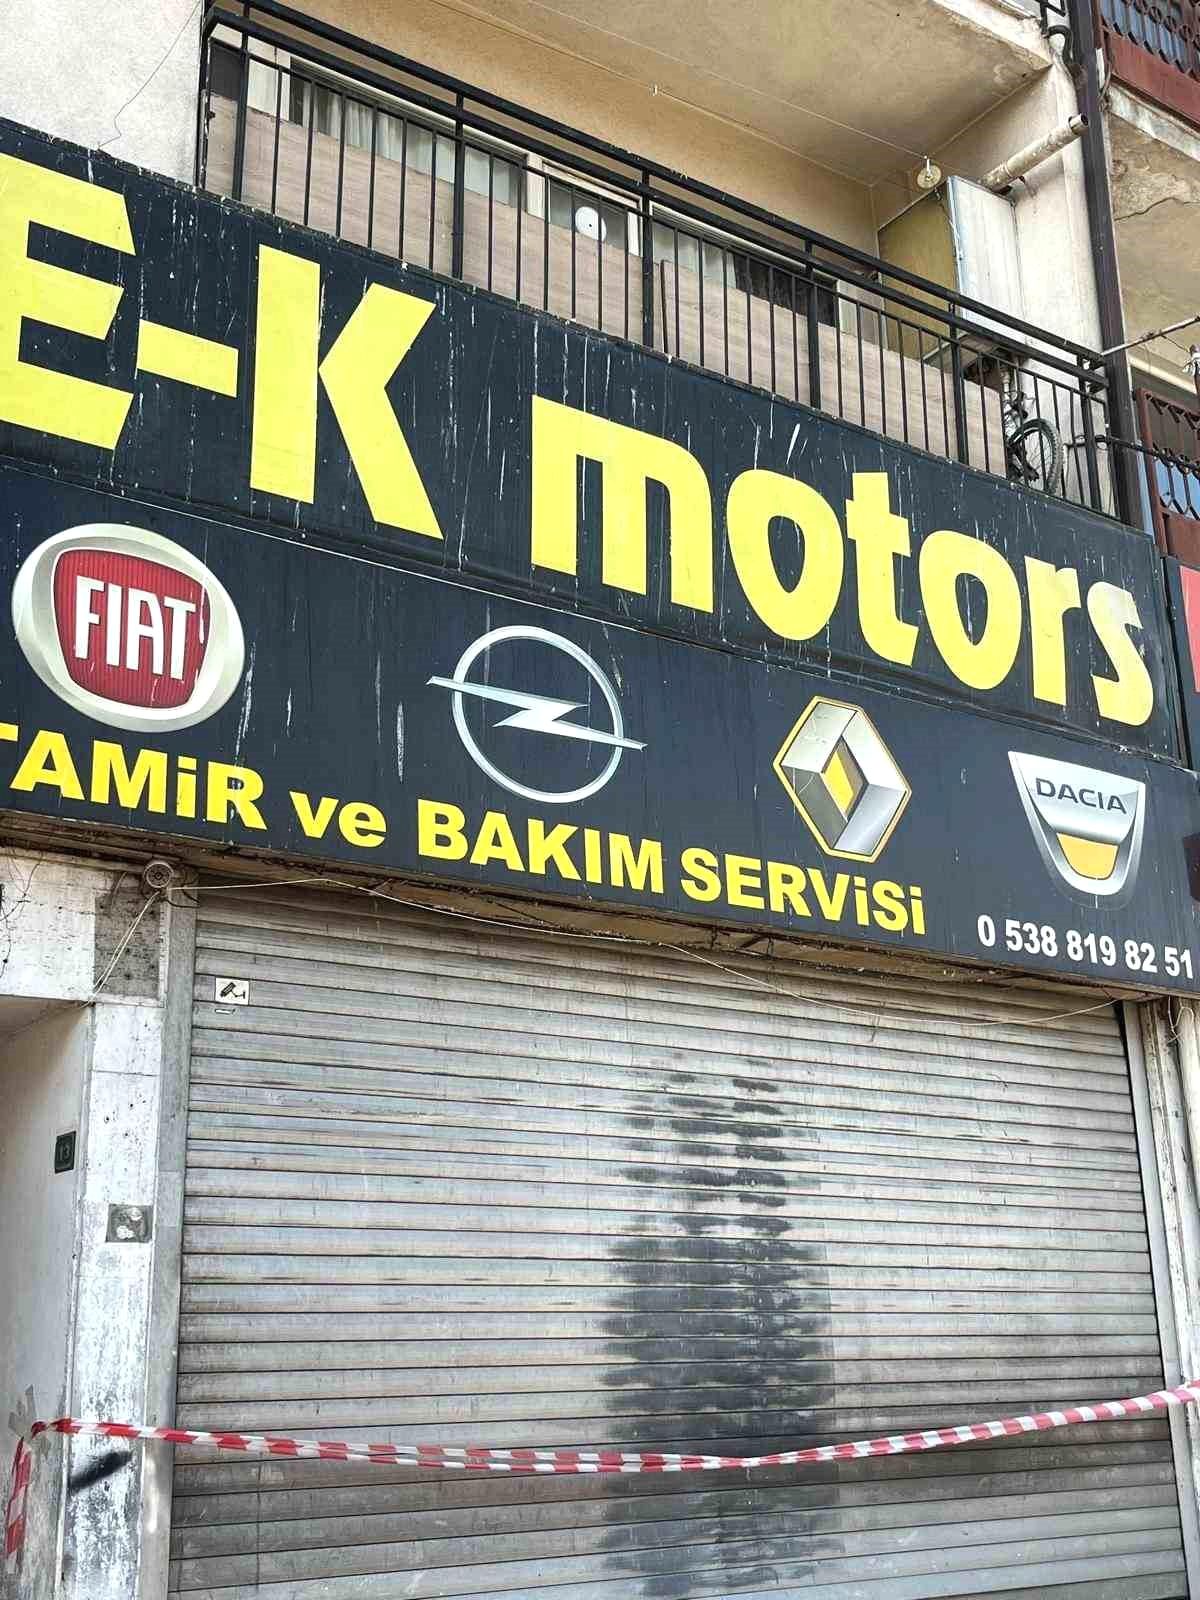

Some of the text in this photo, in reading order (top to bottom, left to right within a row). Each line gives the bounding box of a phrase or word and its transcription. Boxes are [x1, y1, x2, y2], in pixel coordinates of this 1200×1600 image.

[530, 394, 1154, 727] motors
[73, 574, 197, 682] FIAT
[289, 790, 387, 849] ve
[417, 798, 665, 895] BAKIM
[1035, 777, 1127, 815] DACIA
[977, 914, 1194, 980] 0 538 819 82 51
